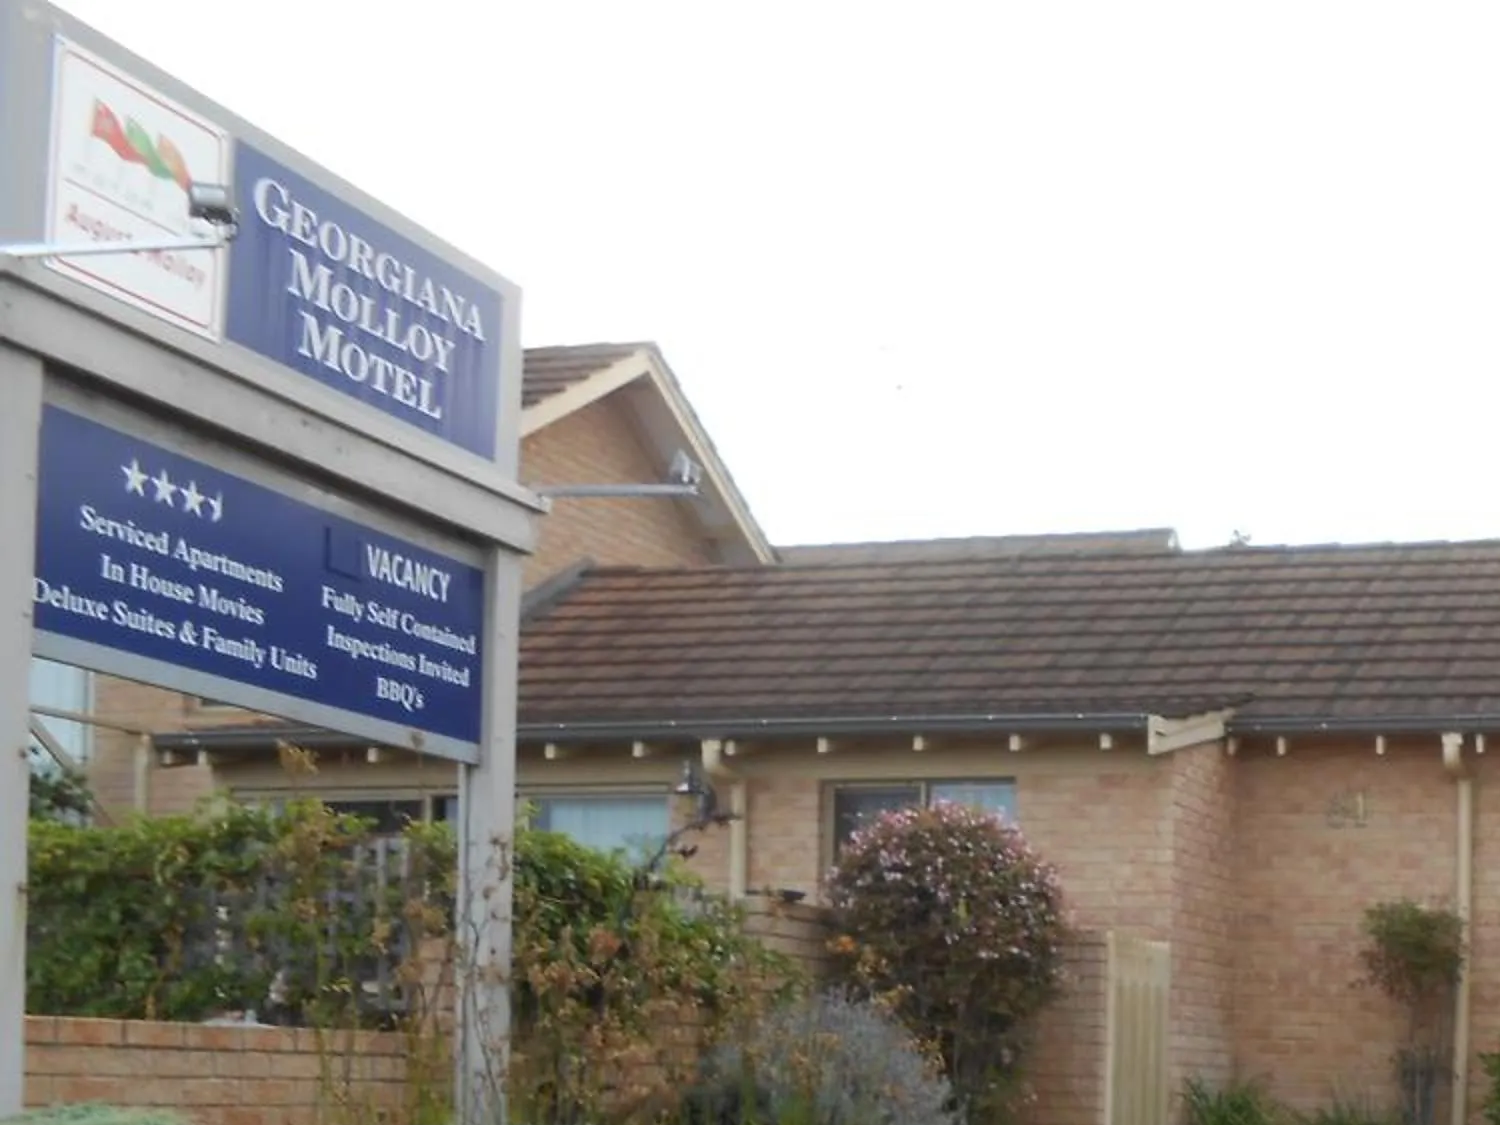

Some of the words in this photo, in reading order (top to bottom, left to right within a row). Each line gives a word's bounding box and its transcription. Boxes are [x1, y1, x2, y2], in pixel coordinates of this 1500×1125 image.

[254, 177, 487, 343] GEORGIANA
[287, 247, 456, 373] MOLLOY
[297, 308, 442, 420] MOTEL
[79, 504, 169, 556] Serviced
[173, 537, 285, 593] Apartments
[100, 552, 125, 583] In
[130, 562, 195, 604] House
[198, 583, 265, 626] Movies
[366, 543, 451, 603] VACANCY
[32, 577, 110, 621] Deluxe
[111, 599, 176, 640] Suites
[179, 619, 198, 646] &
[201, 625, 267, 669] Family
[270, 645, 318, 680] Units
[321, 584, 365, 623] Fully
[367, 600, 400, 630] Self
[400, 612, 477, 655] Contained
[326, 624, 416, 672] Inspections
[418, 652, 471, 688] Invited
[376, 676, 426, 713] BBQ's
